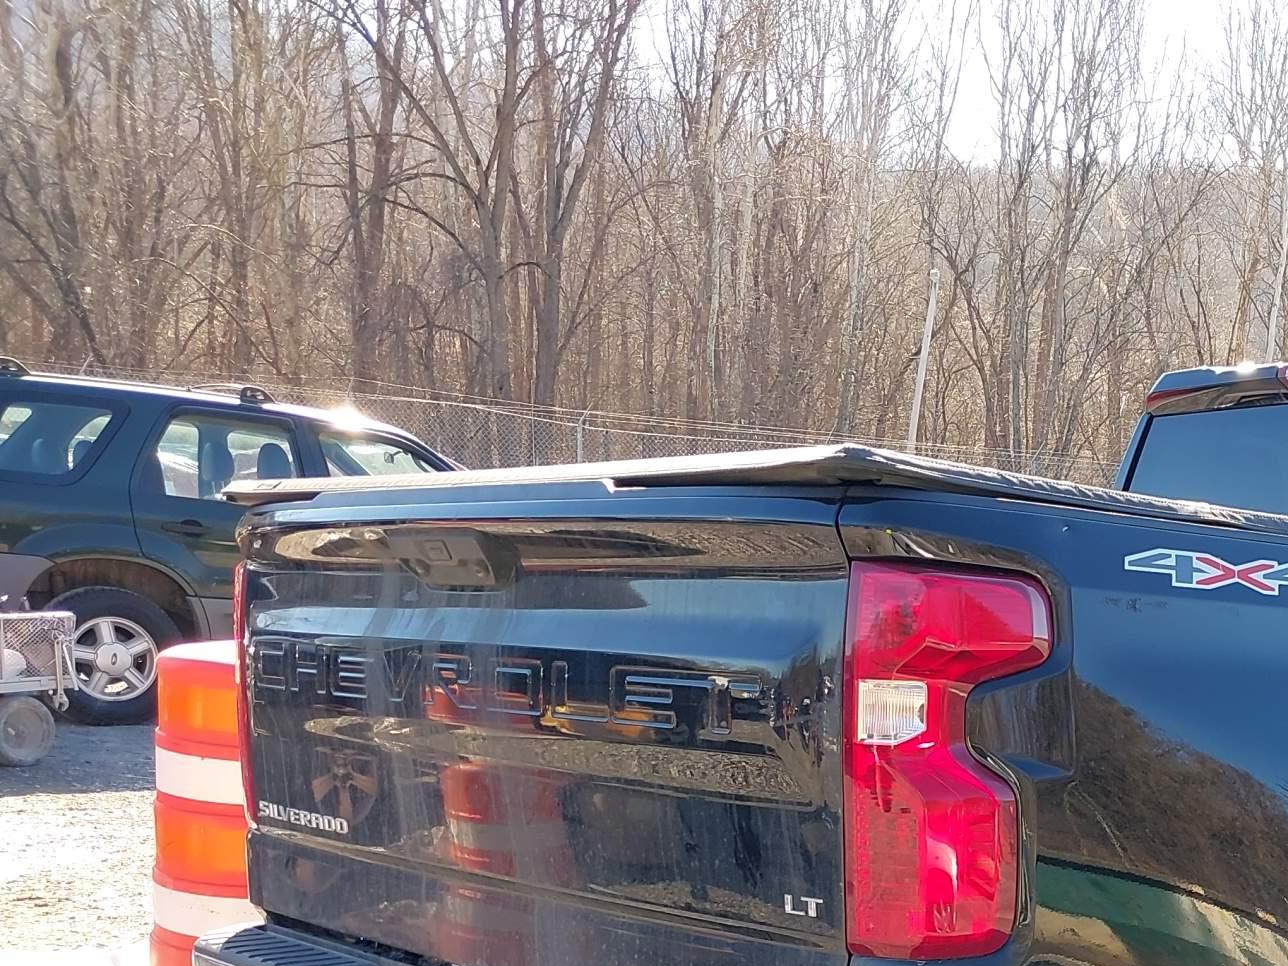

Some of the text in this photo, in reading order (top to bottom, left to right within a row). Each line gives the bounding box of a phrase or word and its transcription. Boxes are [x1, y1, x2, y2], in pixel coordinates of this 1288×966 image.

[252, 637, 763, 735] CHEVROLET
[258, 800, 349, 834] SILVERADO
[784, 894, 823, 917] LT
